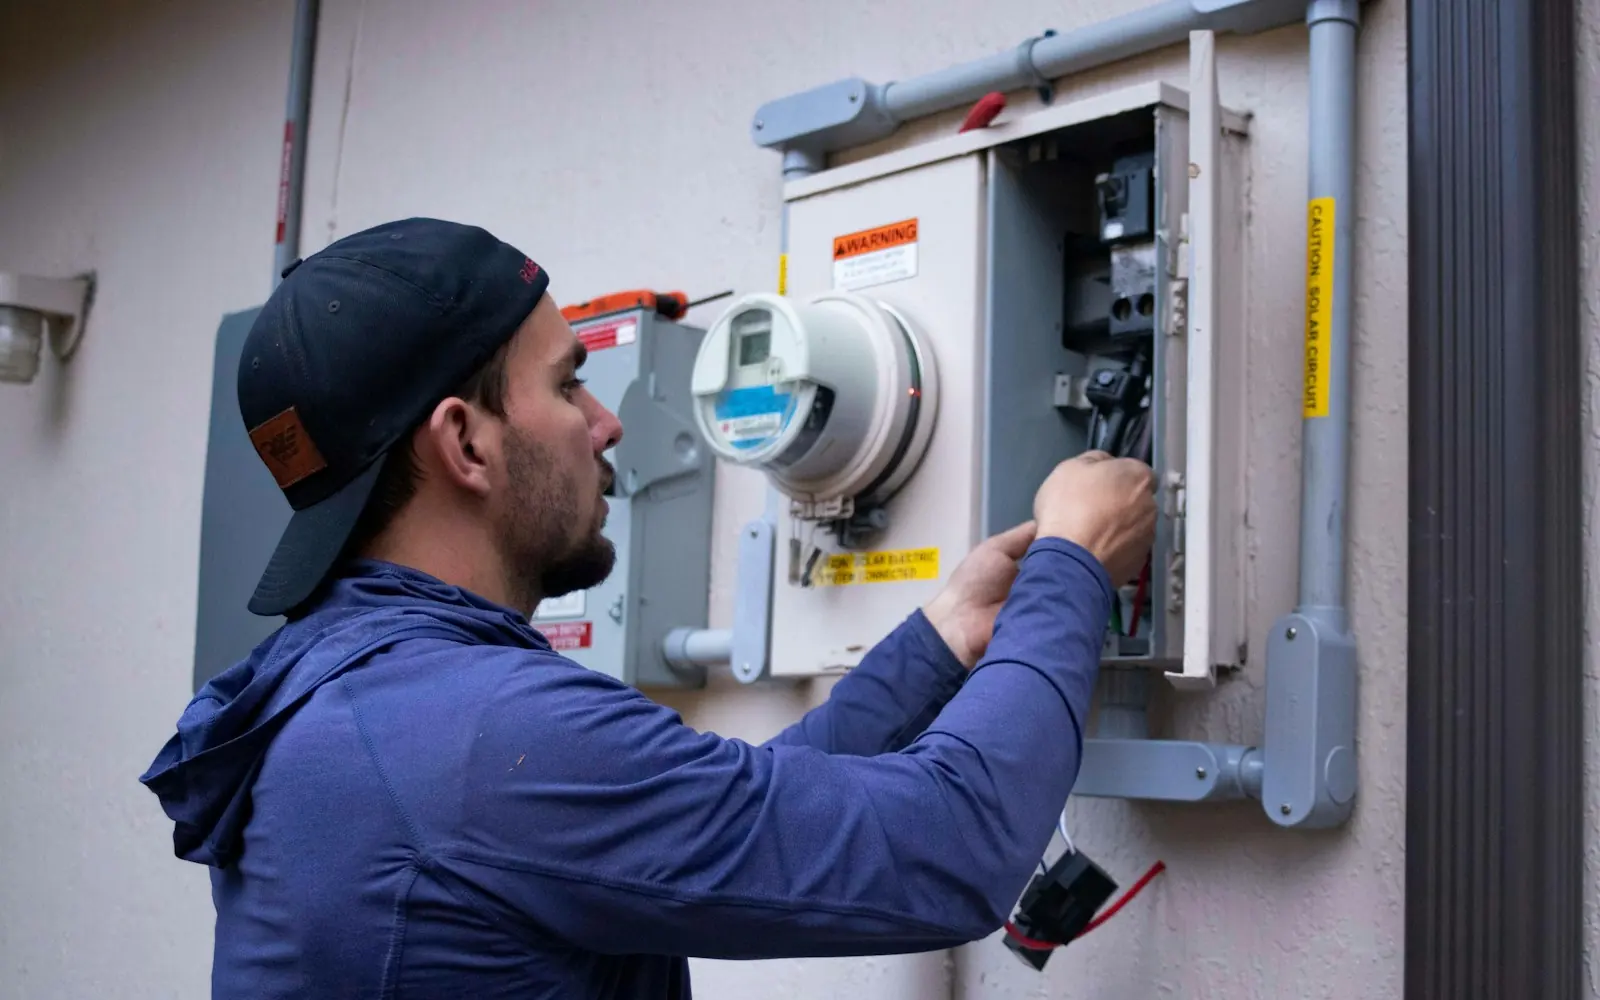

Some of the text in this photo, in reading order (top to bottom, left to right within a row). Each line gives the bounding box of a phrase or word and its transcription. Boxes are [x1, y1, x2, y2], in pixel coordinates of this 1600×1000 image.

[847, 223, 917, 252] WARNING
[1309, 286, 1321, 340] SOLAR
[1305, 346, 1318, 409] CIRCUIT
